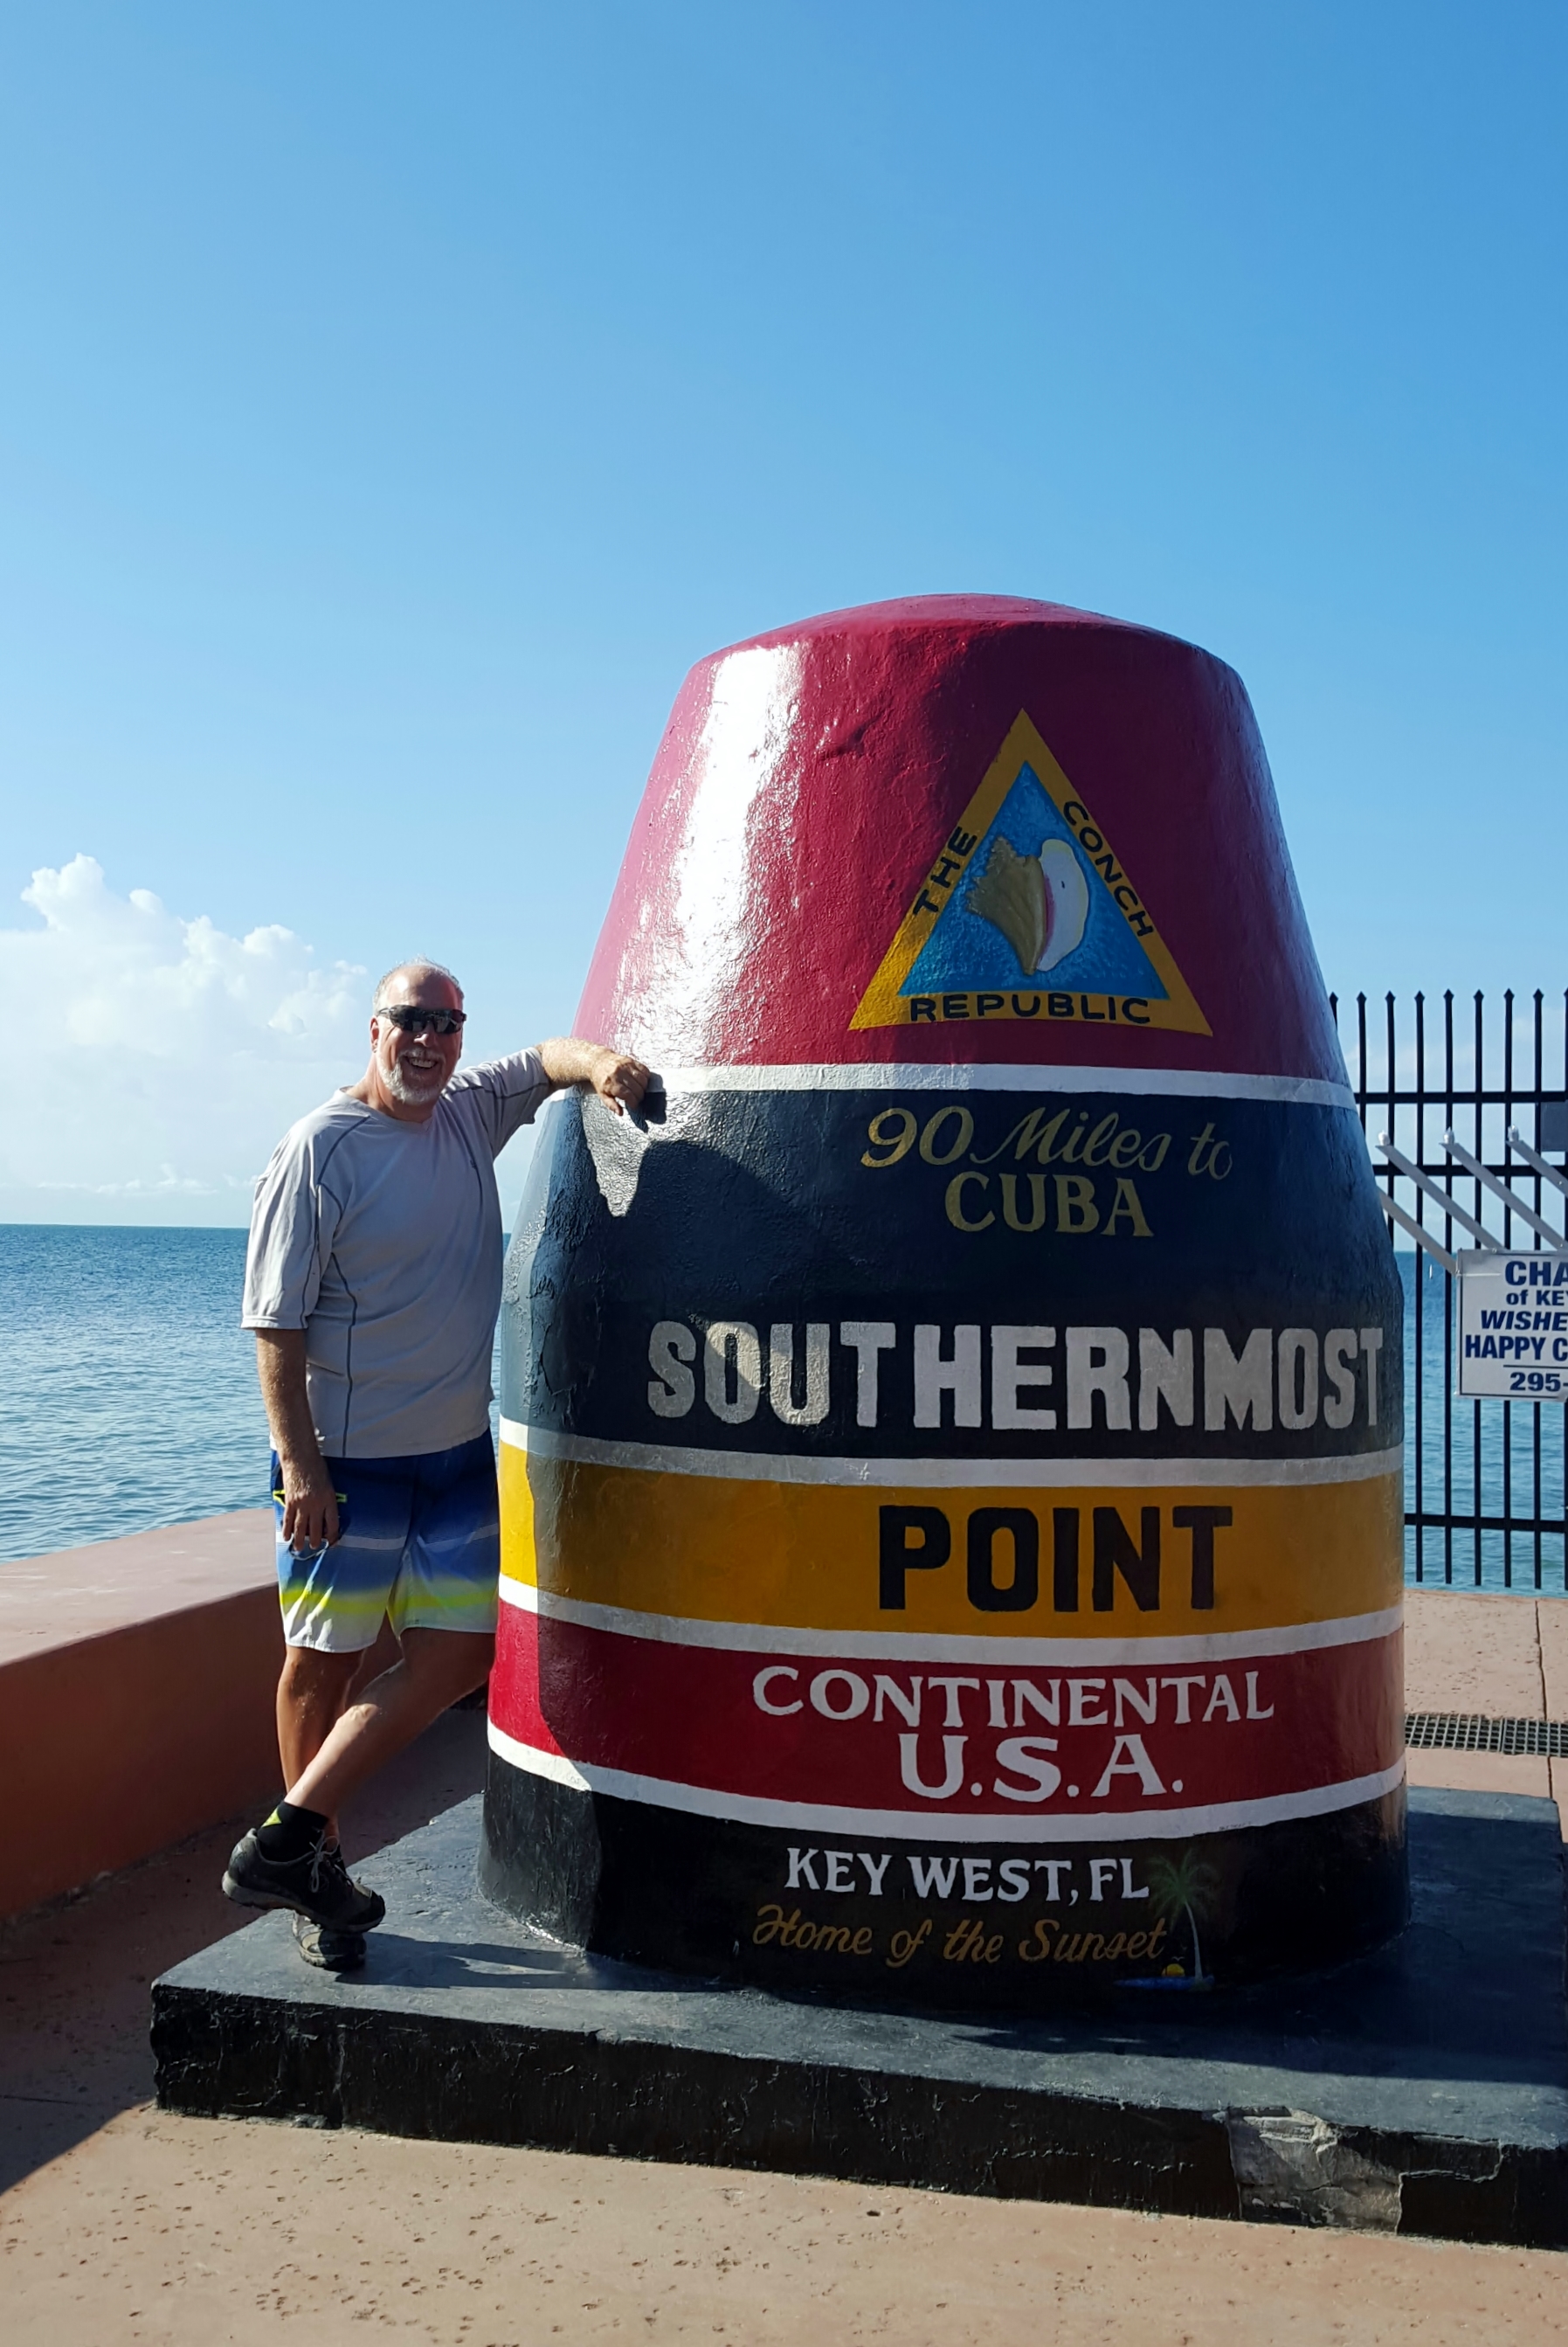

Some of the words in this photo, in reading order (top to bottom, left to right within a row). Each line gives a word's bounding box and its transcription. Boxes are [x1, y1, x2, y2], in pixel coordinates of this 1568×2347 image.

[912, 826, 978, 915] THE
[1062, 800, 1155, 938] CONCH
[909, 993, 1151, 1025] REPUBLIC
[860, 1105, 975, 1168] 90
[970, 1106, 1172, 1173] Miles
[1186, 1120, 1233, 1180] to
[944, 1171, 1155, 1237] CUBA
[1506, 1289, 1529, 1305] of
[646, 1320, 1384, 1432] SOUTHERNMOST
[1465, 1334, 1546, 1360] HAPPY
[878, 1504, 1233, 1613] POINT
[751, 1665, 1274, 1729] CONTINENTAL
[898, 1733, 1184, 1803] U.S.A.
[784, 1846, 893, 1896] KEY
[751, 1903, 874, 1956] Home
[885, 1919, 933, 1969] of
[943, 1919, 1001, 1964] the
[1018, 1918, 1168, 1963] Sunset
